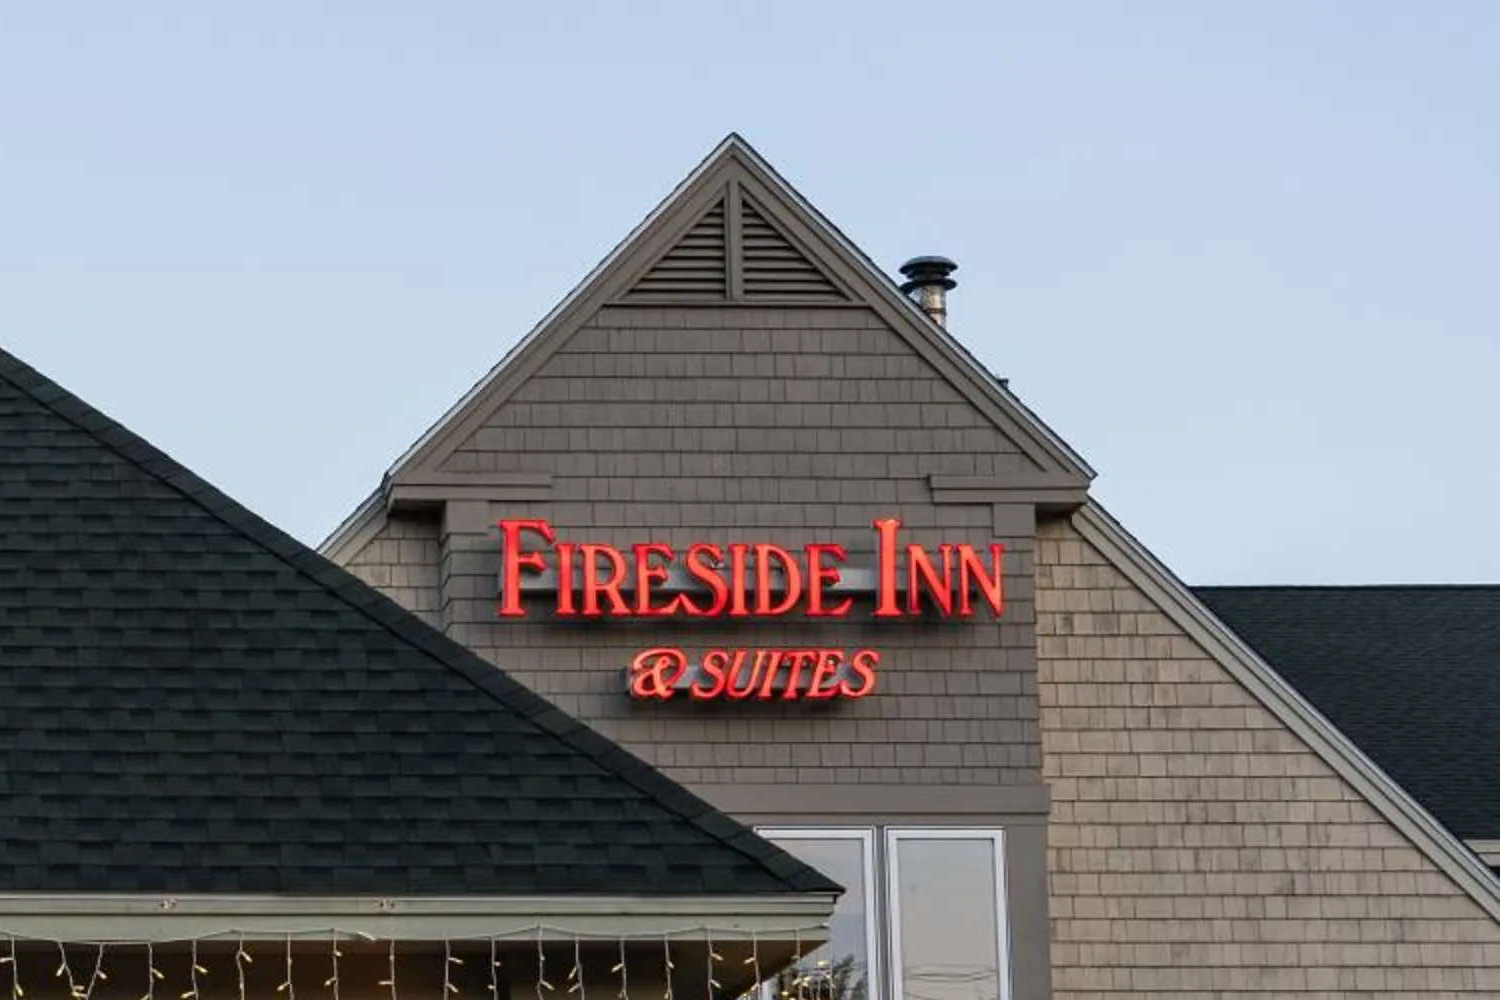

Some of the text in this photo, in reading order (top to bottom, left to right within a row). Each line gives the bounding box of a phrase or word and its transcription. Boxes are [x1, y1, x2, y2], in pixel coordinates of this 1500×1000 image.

[499, 518, 1006, 618] FIRESIDE INN
[690, 647, 882, 700] SUITES
